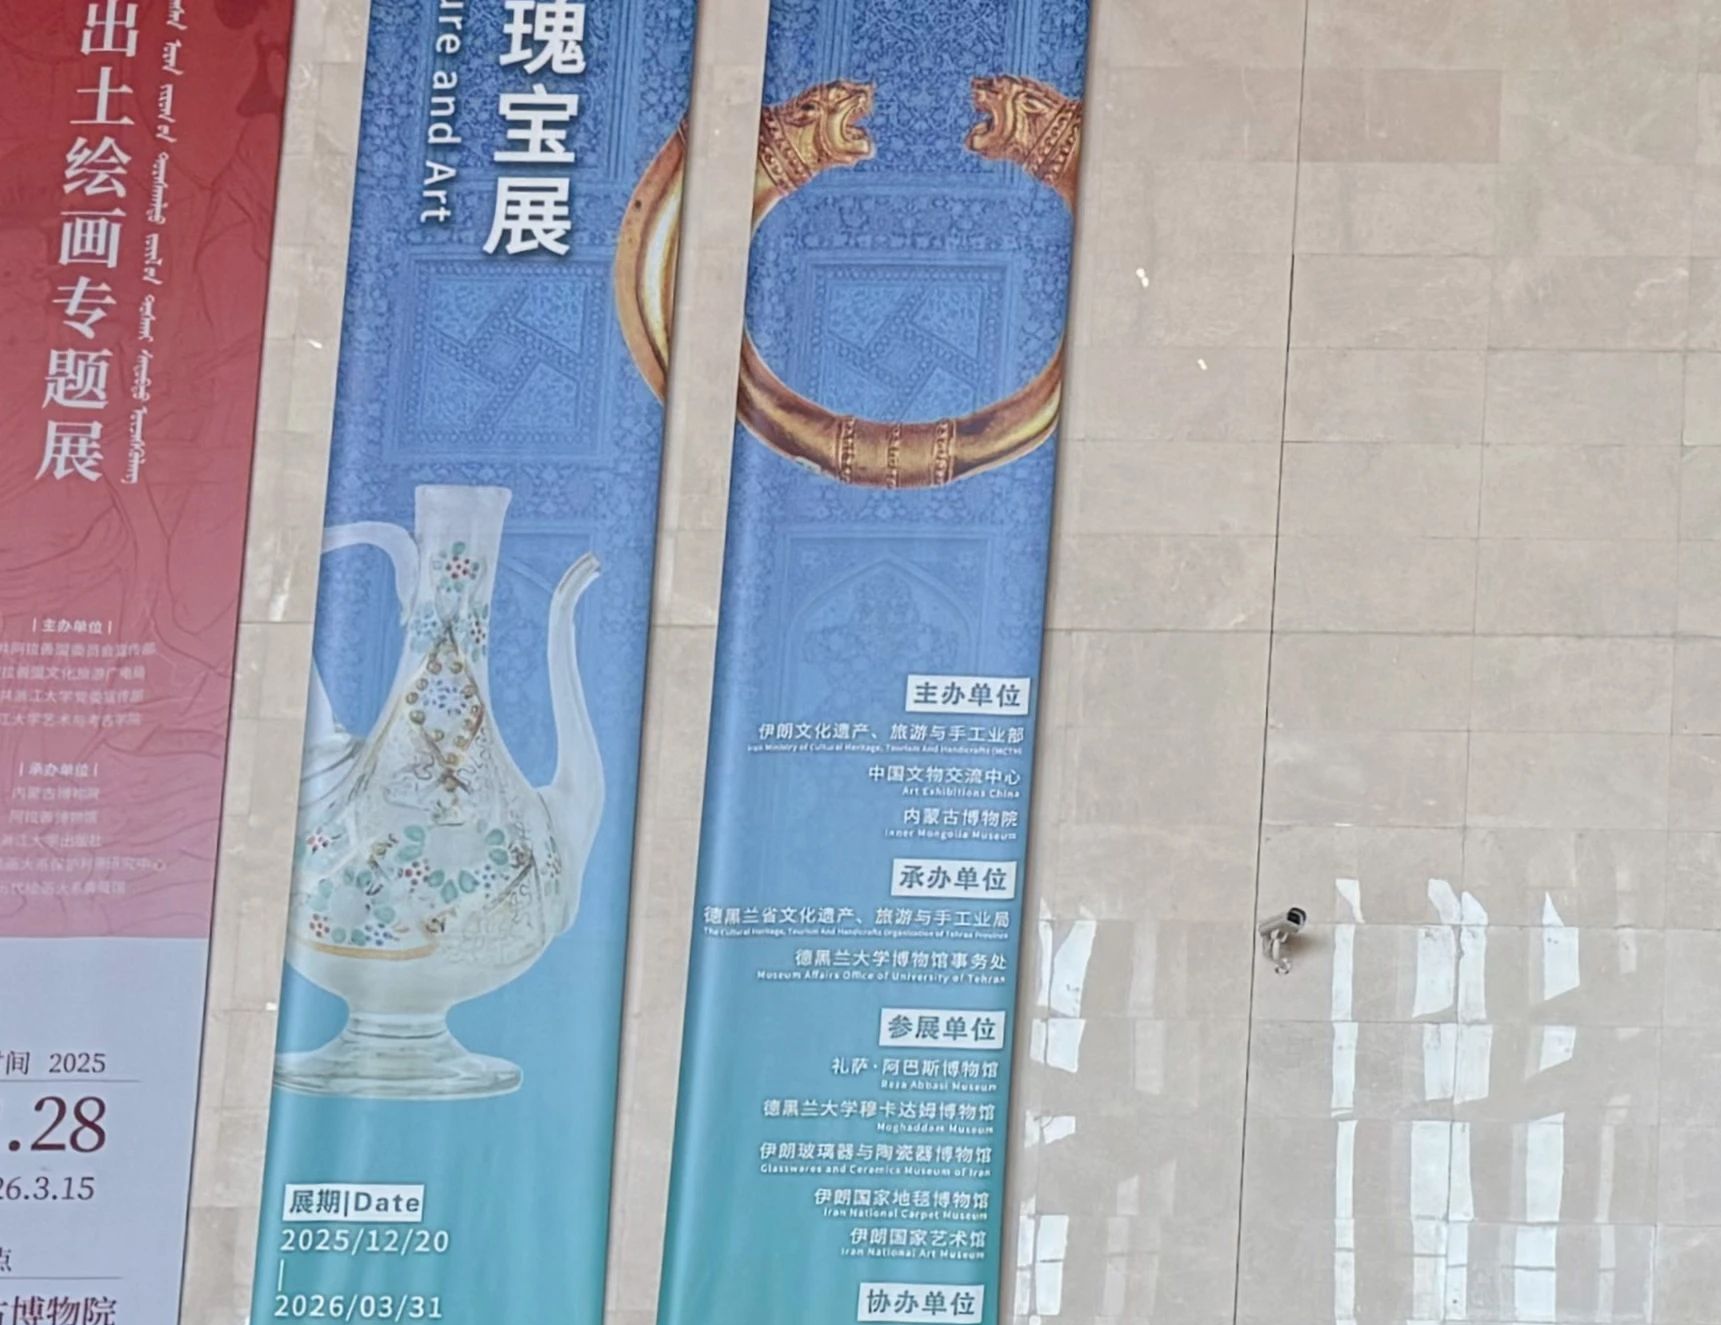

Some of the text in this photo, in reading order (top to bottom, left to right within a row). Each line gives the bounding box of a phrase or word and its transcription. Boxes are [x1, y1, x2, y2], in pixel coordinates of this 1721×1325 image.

[427, 71, 462, 144] and
[483, 0, 586, 258] 瑰宝展
[420, 160, 456, 223] Art
[35, 0, 140, 483] 出土绘画专题展
[913, 681, 1022, 707] 主办单位
[868, 765, 1021, 785] 中国文物交流中心
[902, 786, 919, 797] Art
[903, 807, 1018, 827] 内蒙古博物院
[899, 865, 1007, 891] 承办单位
[795, 948, 1007, 971] 德黑兰大学博物馆事务处
[877, 972, 889, 982] of
[952, 973, 965, 983] of
[888, 1013, 996, 1041] 参展单位
[0, 1051, 106, 1076] 间 2025
[832, 1057, 998, 1079] 礼萨·阿巴斯博物馆
[763, 1098, 995, 1121] 德黑兰大学穆卡达姆博物馆
[760, 1142, 992, 1164] 伊朗玻璃器与陶瓷器博物馆
[825, 1165, 847, 1175] and
[954, 1167, 966, 1177] of
[969, 1167, 991, 1177] Iran
[814, 1187, 989, 1209] 伊朗国家地毯博物馆
[280, 1228, 449, 1256] 2025/12/20
[850, 1227, 986, 1248] 伊朗国家艺术馆
[918, 1248, 936, 1259] Art
[273, 1294, 443, 1322] 2026/03/31
[866, 1289, 976, 1316] 协办单位
